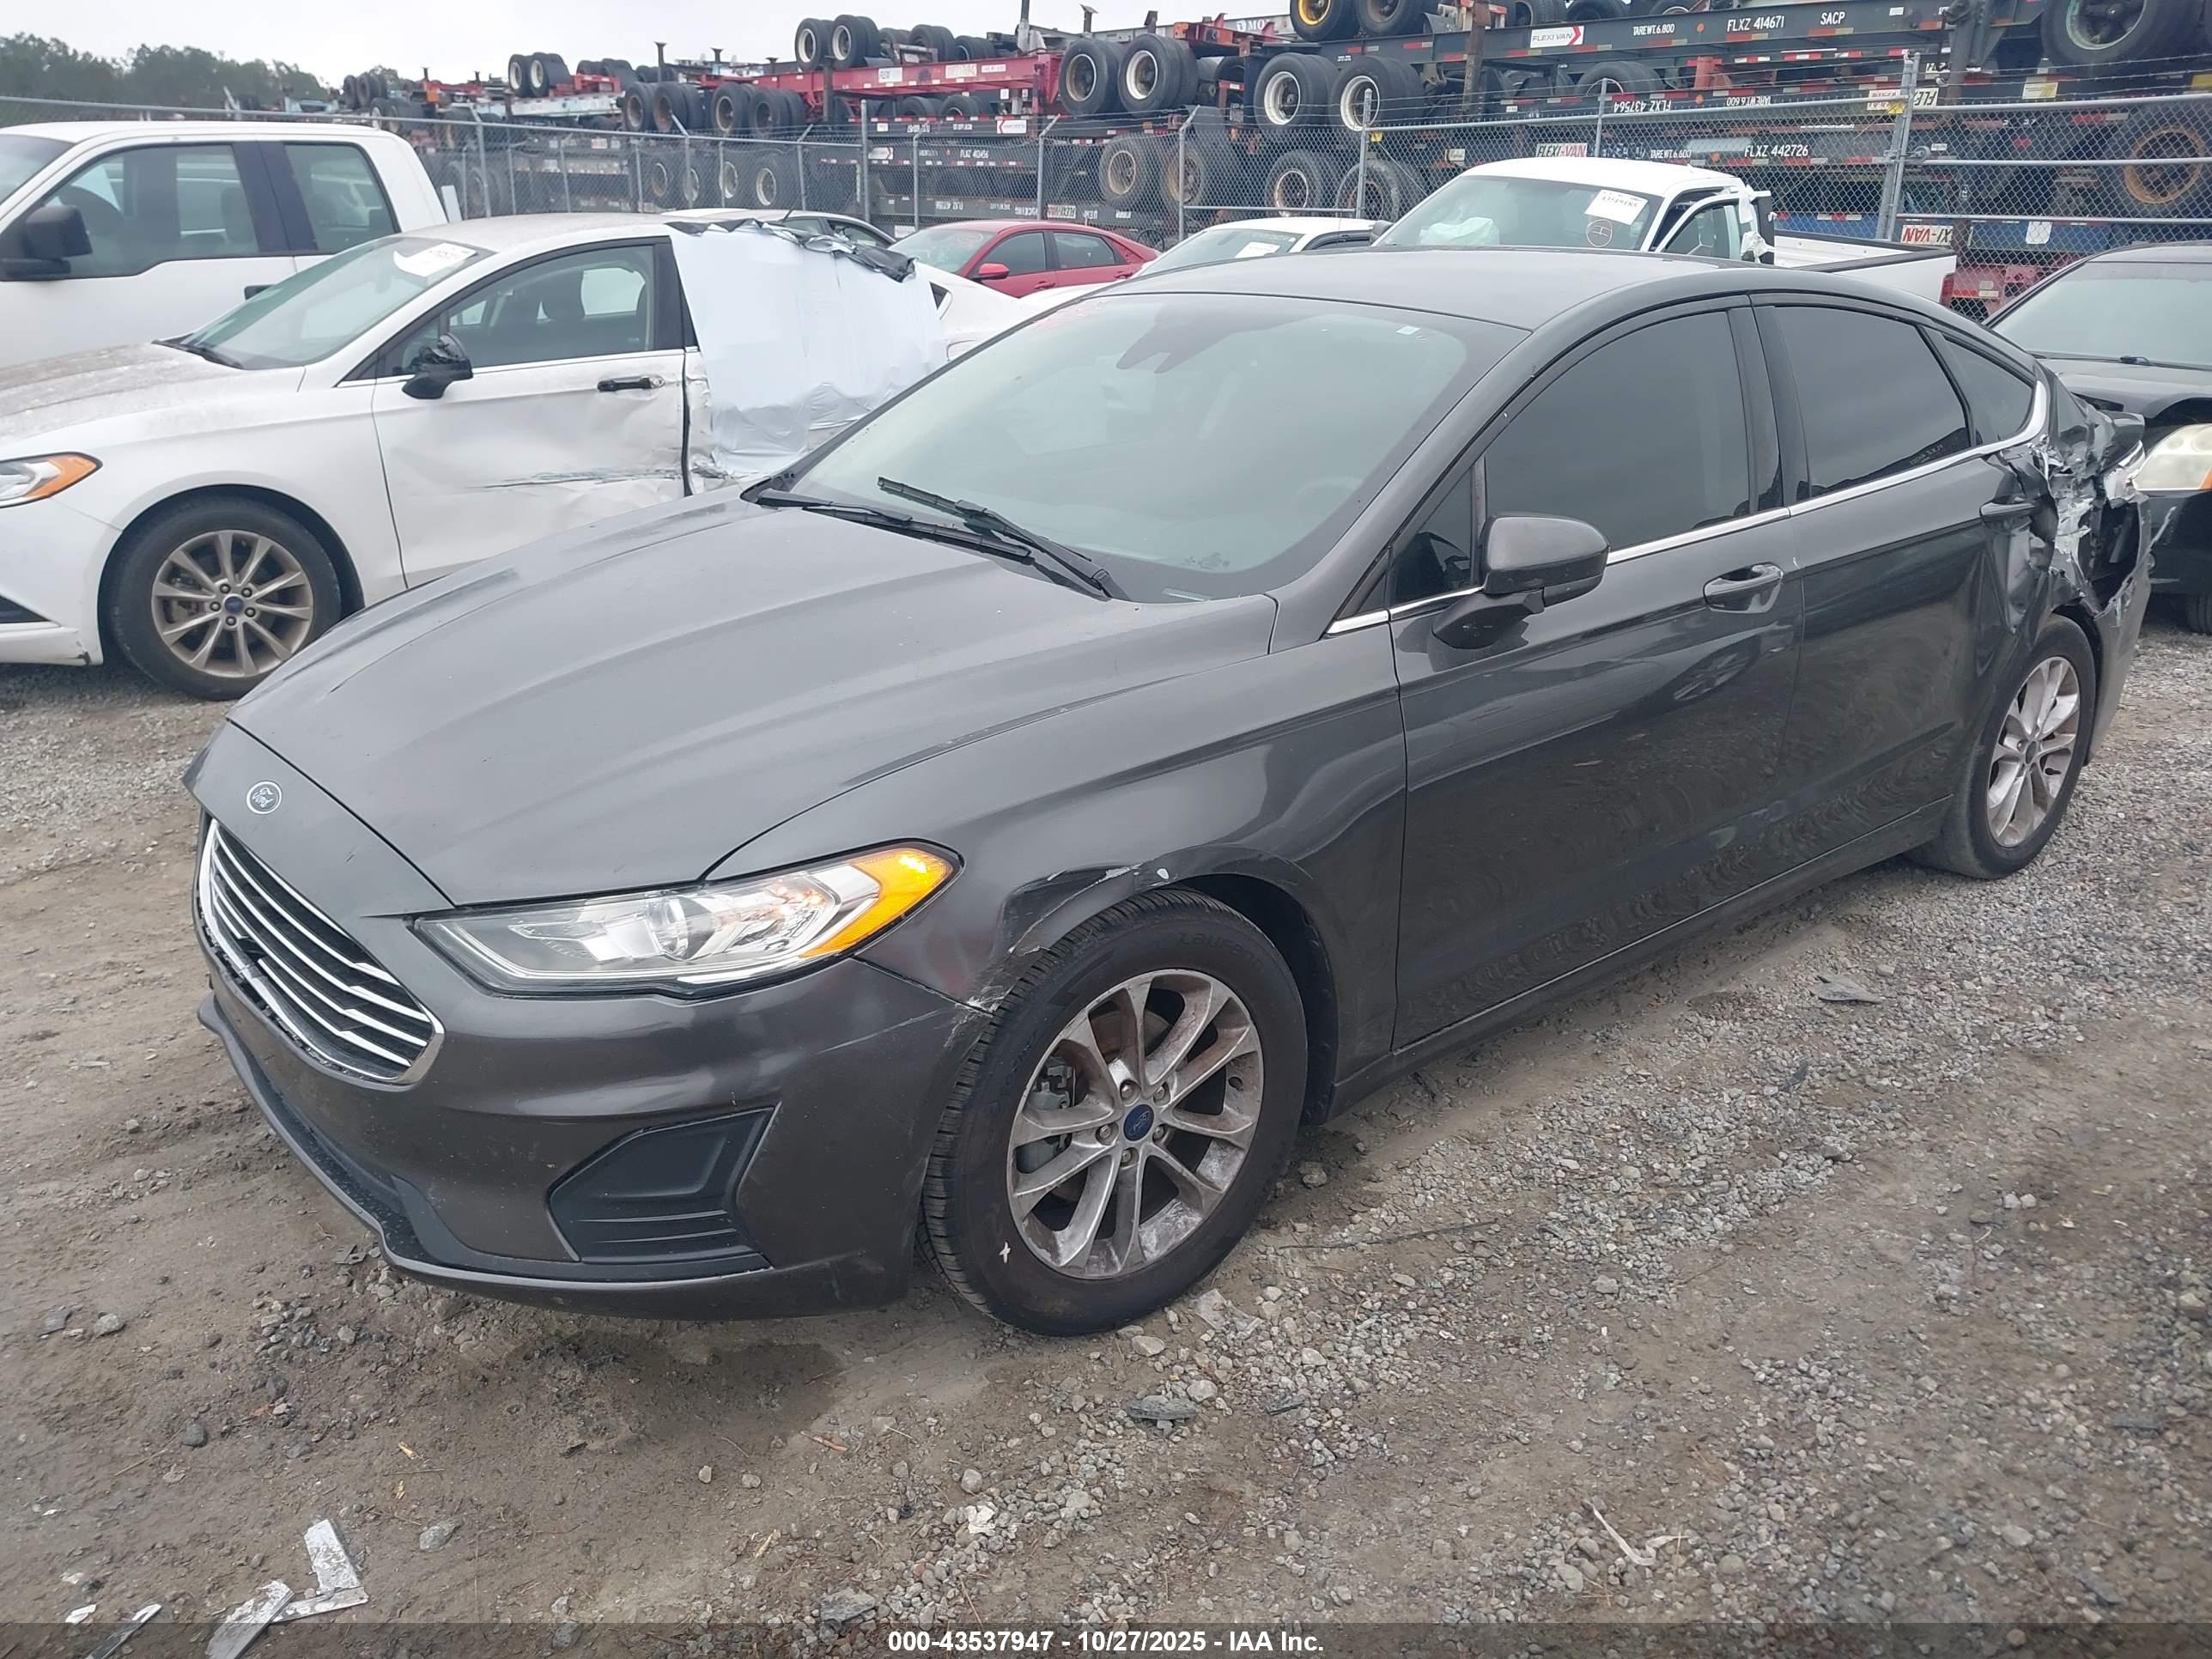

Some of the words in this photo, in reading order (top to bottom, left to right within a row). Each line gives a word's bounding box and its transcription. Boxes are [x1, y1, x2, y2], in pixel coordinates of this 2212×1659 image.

[1727, 18, 1752, 32] FLXZ
[1753, 15, 1785, 30] 414671
[1820, 11, 1845, 25] SACP
[1613, 100, 1647, 113] 437564
[1649, 100, 1672, 112] FLXZ
[1744, 144, 1769, 157] FLXZ
[1771, 144, 1808, 157] 442726
